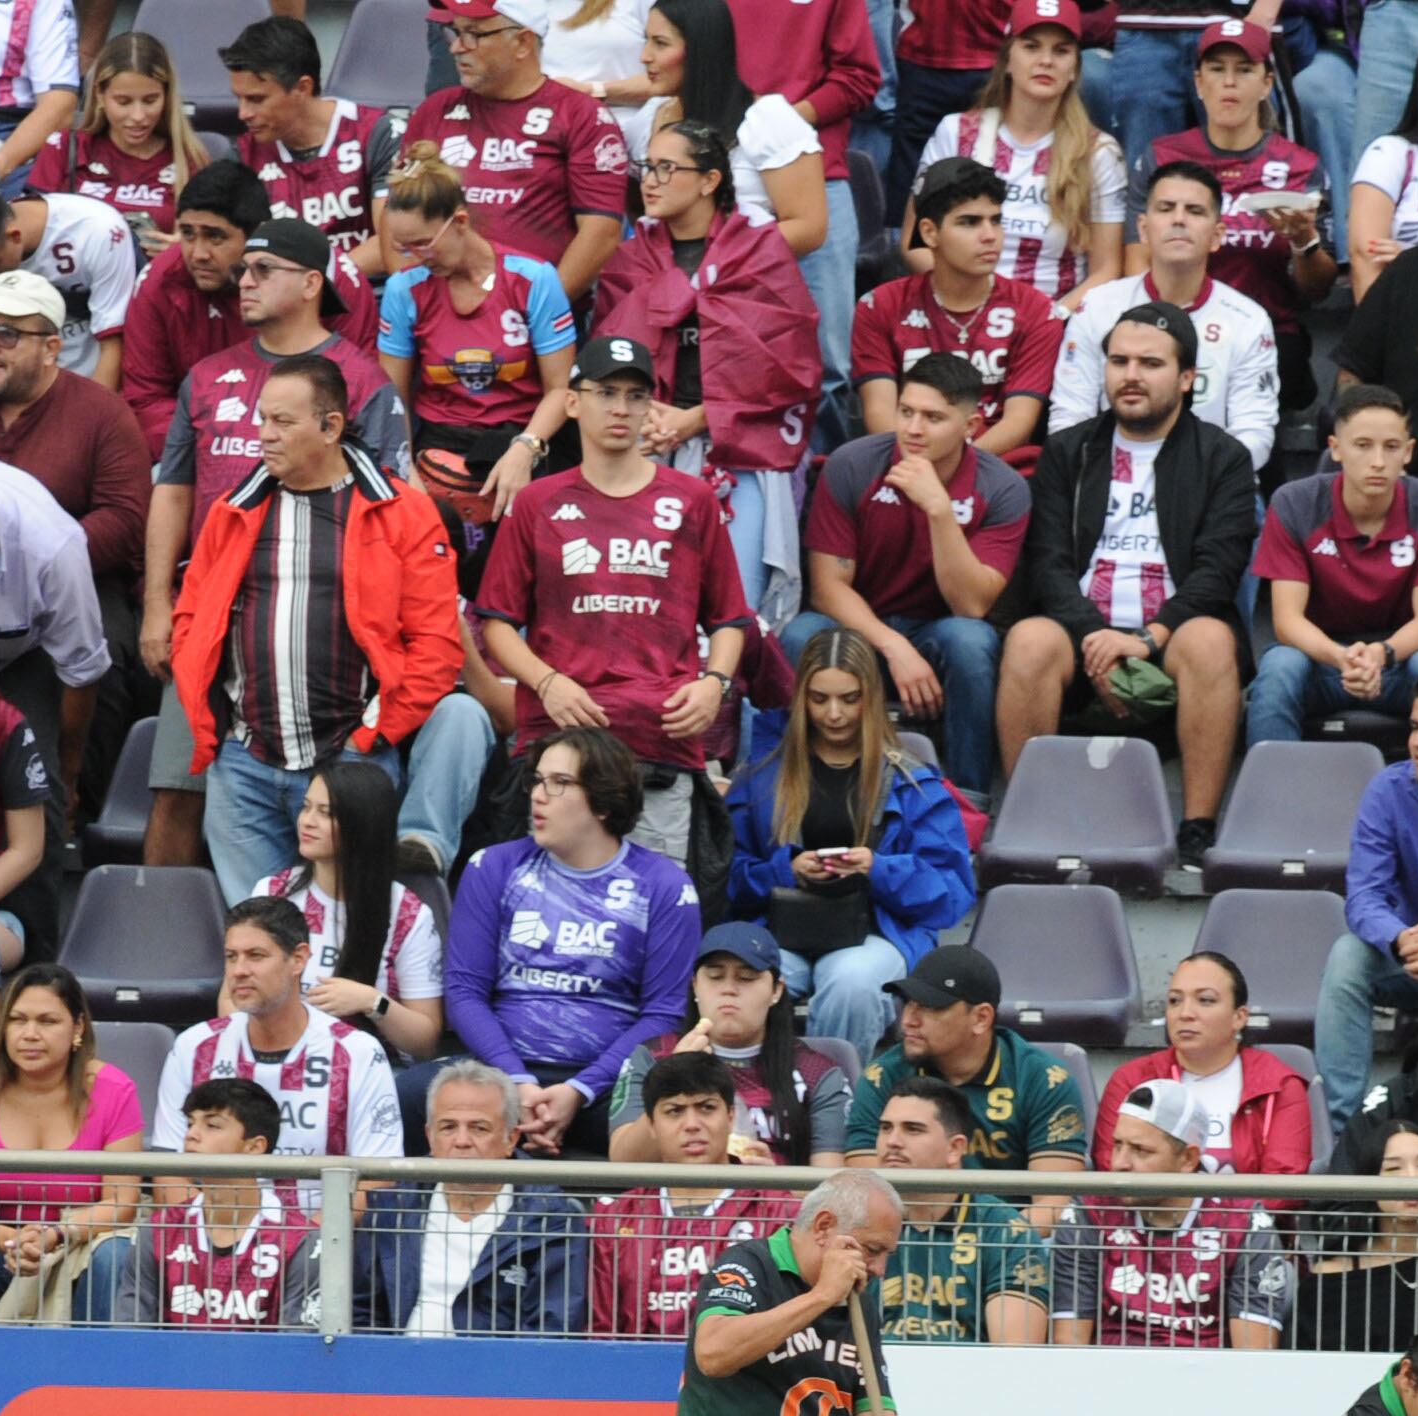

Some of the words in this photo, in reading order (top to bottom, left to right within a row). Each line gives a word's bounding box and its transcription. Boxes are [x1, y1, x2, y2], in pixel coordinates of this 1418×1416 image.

[1038, 0, 1060, 18] S
[1221, 18, 1244, 37] S
[522, 107, 553, 136] S
[337, 139, 362, 174] S
[482, 138, 537, 164] BAC
[1261, 161, 1290, 190] S
[115, 184, 165, 202] BAC
[302, 185, 365, 227] BAC
[52, 242, 77, 275] S
[500, 308, 529, 348] S
[986, 306, 1016, 339] S
[1204, 322, 1222, 343] S
[610, 340, 634, 362] S
[779, 403, 809, 447] S
[211, 436, 261, 457] LIBE
[652, 497, 684, 531] S
[1130, 492, 1156, 517] BA
[609, 538, 672, 570] BAC
[1391, 535, 1415, 568] S
[571, 595, 661, 617] LIBERTY
[604, 879, 636, 910] S
[555, 920, 618, 950] BAC
[509, 965, 603, 994] LIBERTY
[303, 1056, 329, 1089] S
[986, 1087, 1013, 1121] S
[950, 1232, 978, 1264] S
[1190, 1227, 1222, 1261] S
[250, 1244, 279, 1279] S
[659, 1247, 709, 1276] BA
[907, 1273, 967, 1307] BAC
[1146, 1272, 1211, 1304] BAC
[205, 1289, 269, 1322] BAC
